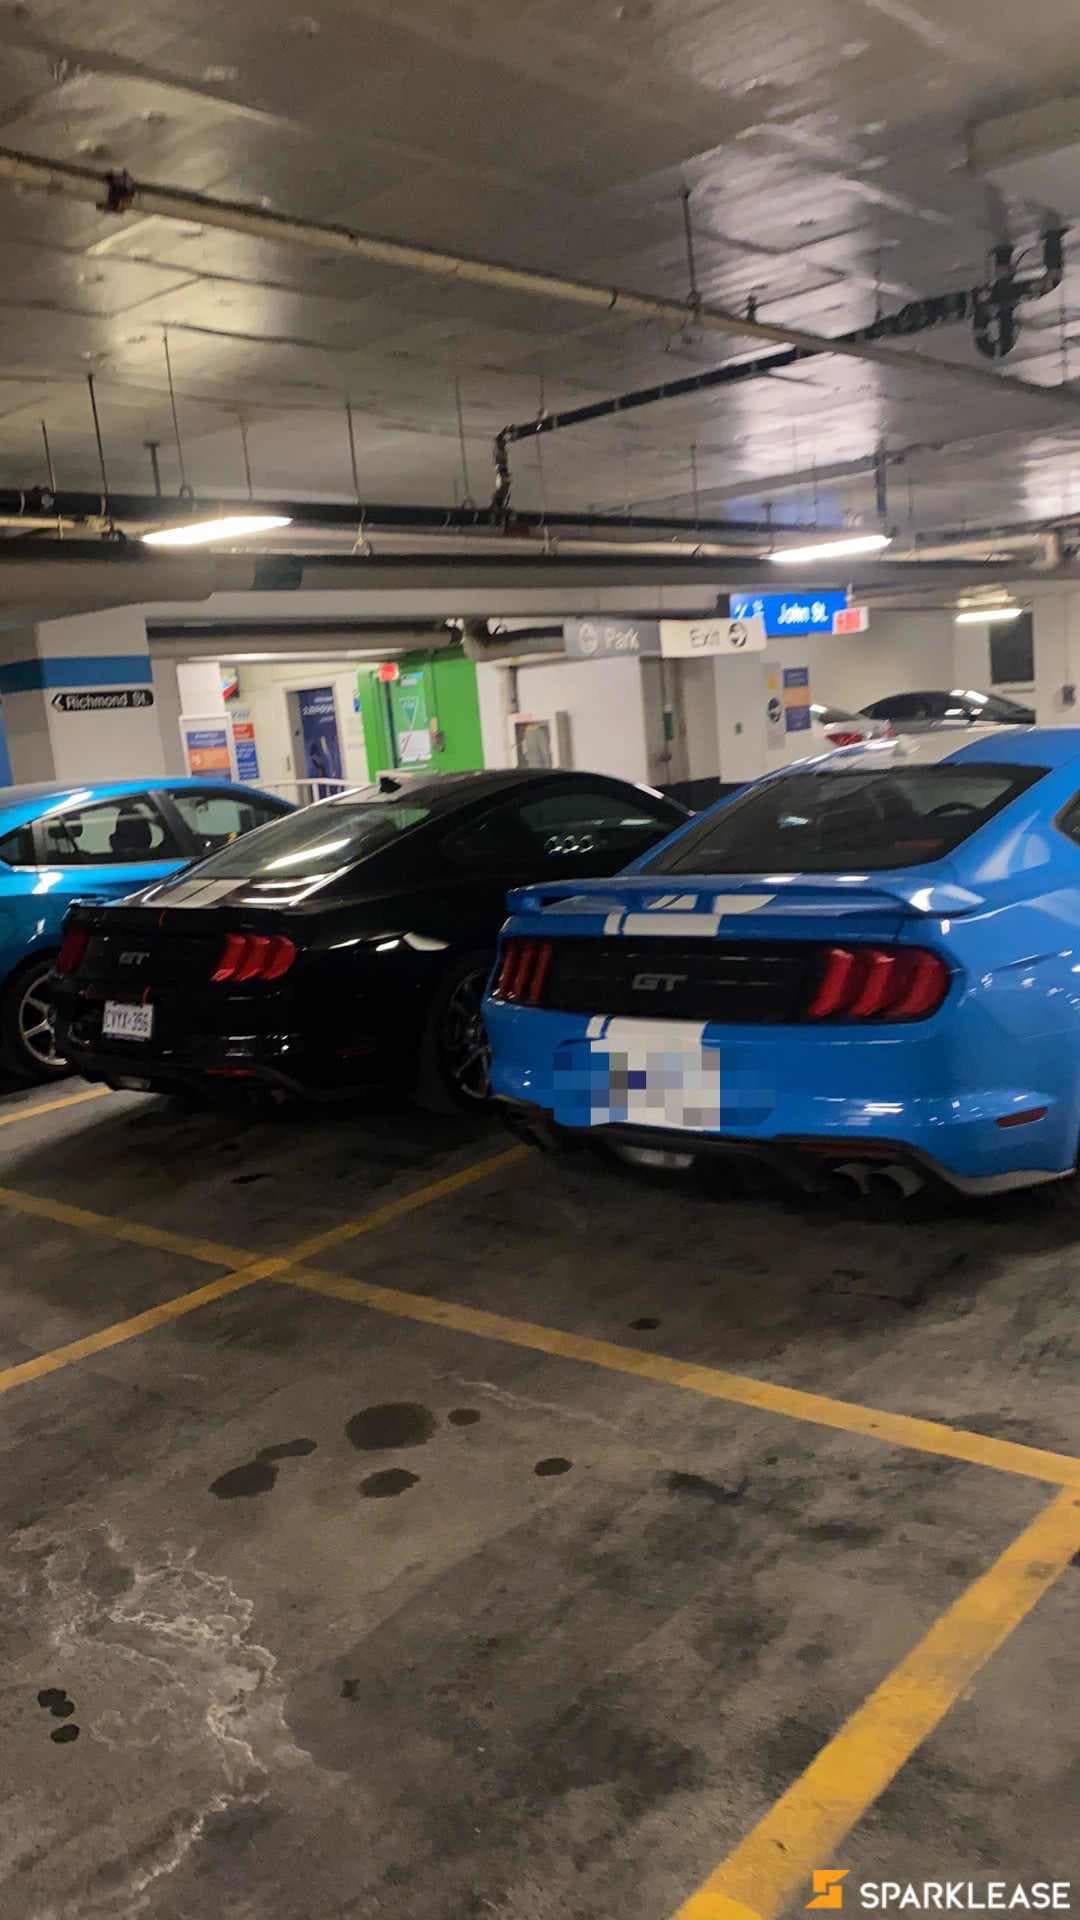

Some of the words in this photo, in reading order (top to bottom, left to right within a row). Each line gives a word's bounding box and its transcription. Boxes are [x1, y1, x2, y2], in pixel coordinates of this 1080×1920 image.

[777, 602, 810, 625] John
[604, 627, 640, 650] Park
[689, 628, 720, 648] Exit
[65, 691, 128, 711] Richmond
[119, 951, 151, 966] GT
[632, 973, 689, 991] GT
